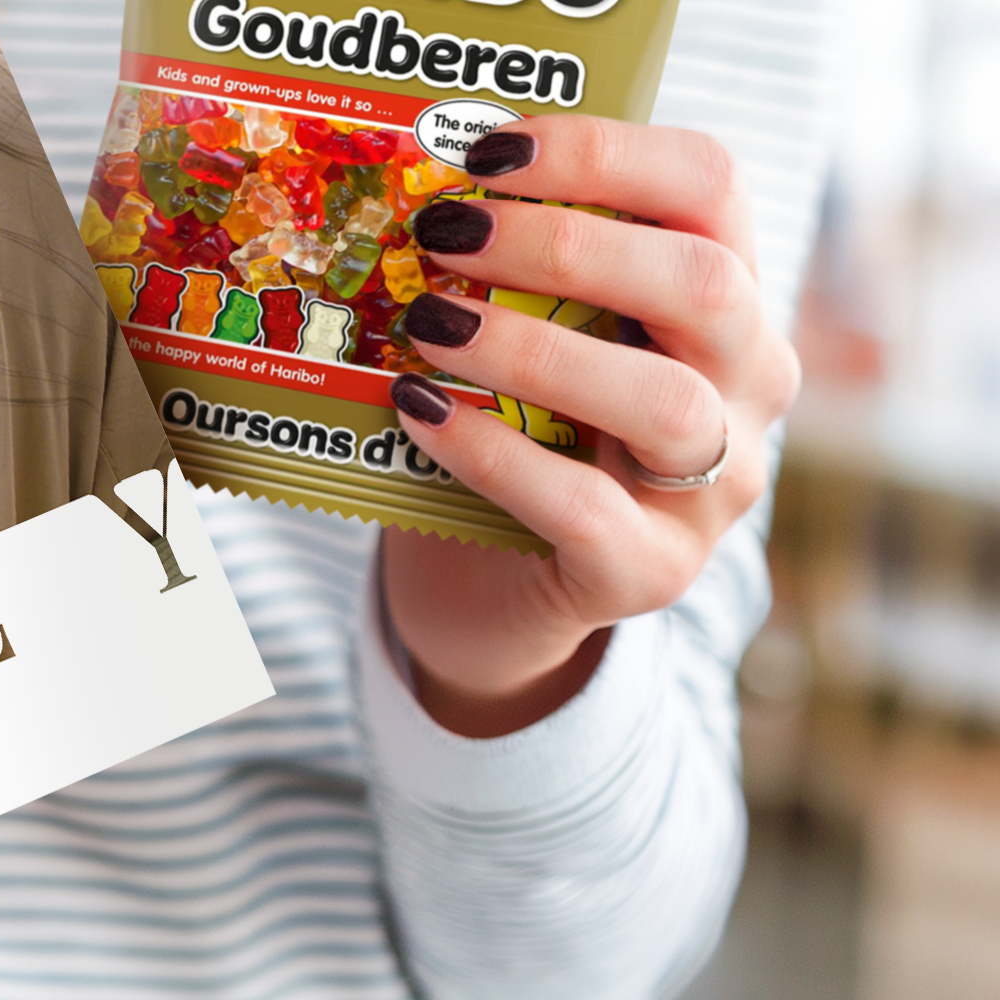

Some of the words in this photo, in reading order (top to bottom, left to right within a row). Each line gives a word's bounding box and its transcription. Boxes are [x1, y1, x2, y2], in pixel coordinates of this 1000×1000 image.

[157, 66, 188, 83] Kids
[191, 73, 220, 88] and
[223, 79, 302, 102] grown-ups
[306, 89, 336, 106] love
[340, 94, 352, 108] it
[354, 100, 372, 112] so
[434, 114, 460, 131] The
[464, 120, 498, 137] orig
[434, 134, 471, 153] since
[128, 336, 151, 352] the
[155, 340, 201, 364] happy
[205, 353, 247, 371] world
[251, 361, 267, 375] of
[270, 364, 326, 386] Haribo!
[162, 390, 354, 461] Oursons
